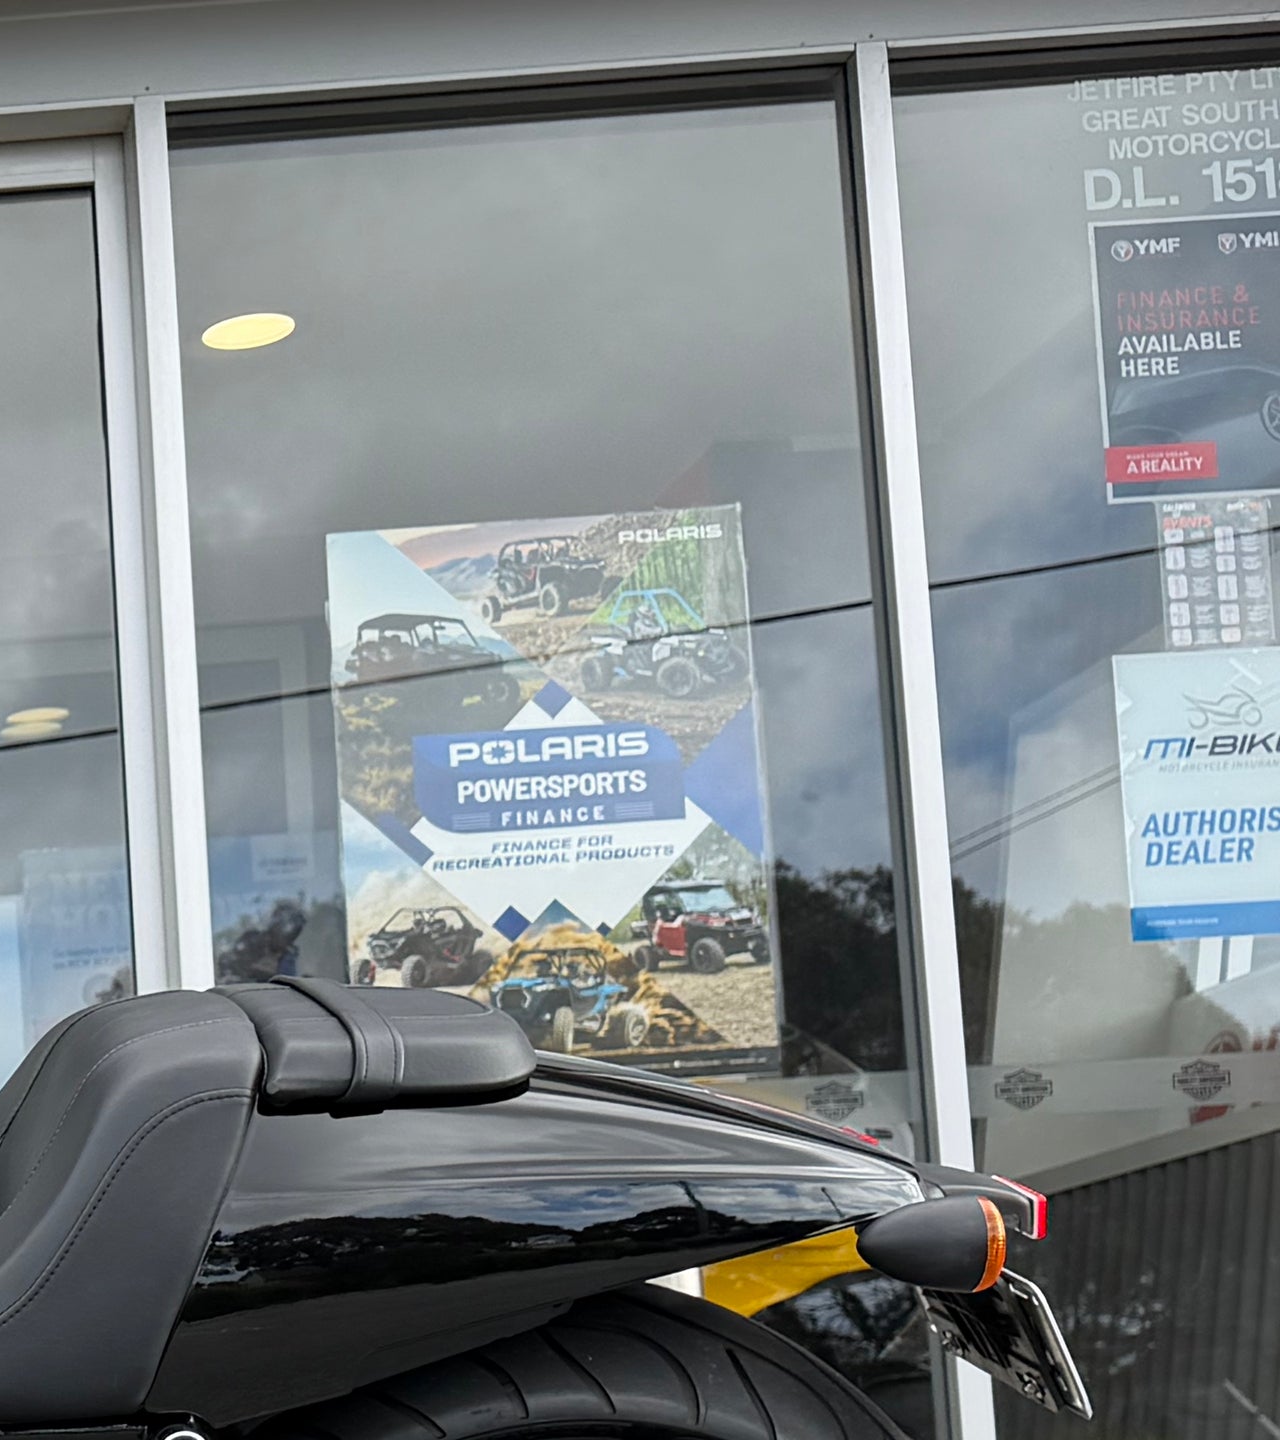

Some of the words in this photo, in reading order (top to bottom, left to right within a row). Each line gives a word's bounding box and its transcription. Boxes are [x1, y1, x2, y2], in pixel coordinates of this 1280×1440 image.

[1067, 74, 1176, 101] JETFIRE
[1185, 69, 1240, 93] PTY
[1250, 66, 1280, 89] LT
[1082, 105, 1173, 132] GREAT
[1083, 166, 1180, 211] D.L.
[1202, 157, 1280, 202] 151
[1134, 237, 1181, 255] YMF
[1116, 286, 1224, 310] FINANCE
[1233, 283, 1249, 304] &
[1117, 306, 1261, 333] INSURANCE
[1117, 329, 1242, 355] AVAILABLE
[1120, 356, 1180, 378] HERE
[1126, 460, 1139, 474] A
[1141, 456, 1203, 473] REALITY
[618, 524, 722, 544] POLARIS
[449, 731, 649, 767] POLARIS
[1143, 732, 1280, 760] MI-BIK
[457, 769, 648, 804] POWERSPORTS
[501, 805, 606, 827] FINANCE
[491, 837, 572, 853] FINANCE
[577, 834, 614, 848] FOR
[1145, 837, 1255, 867] DEALER
[433, 851, 571, 871] RECREATIONAL
[575, 844, 675, 863] PRODUCTS
